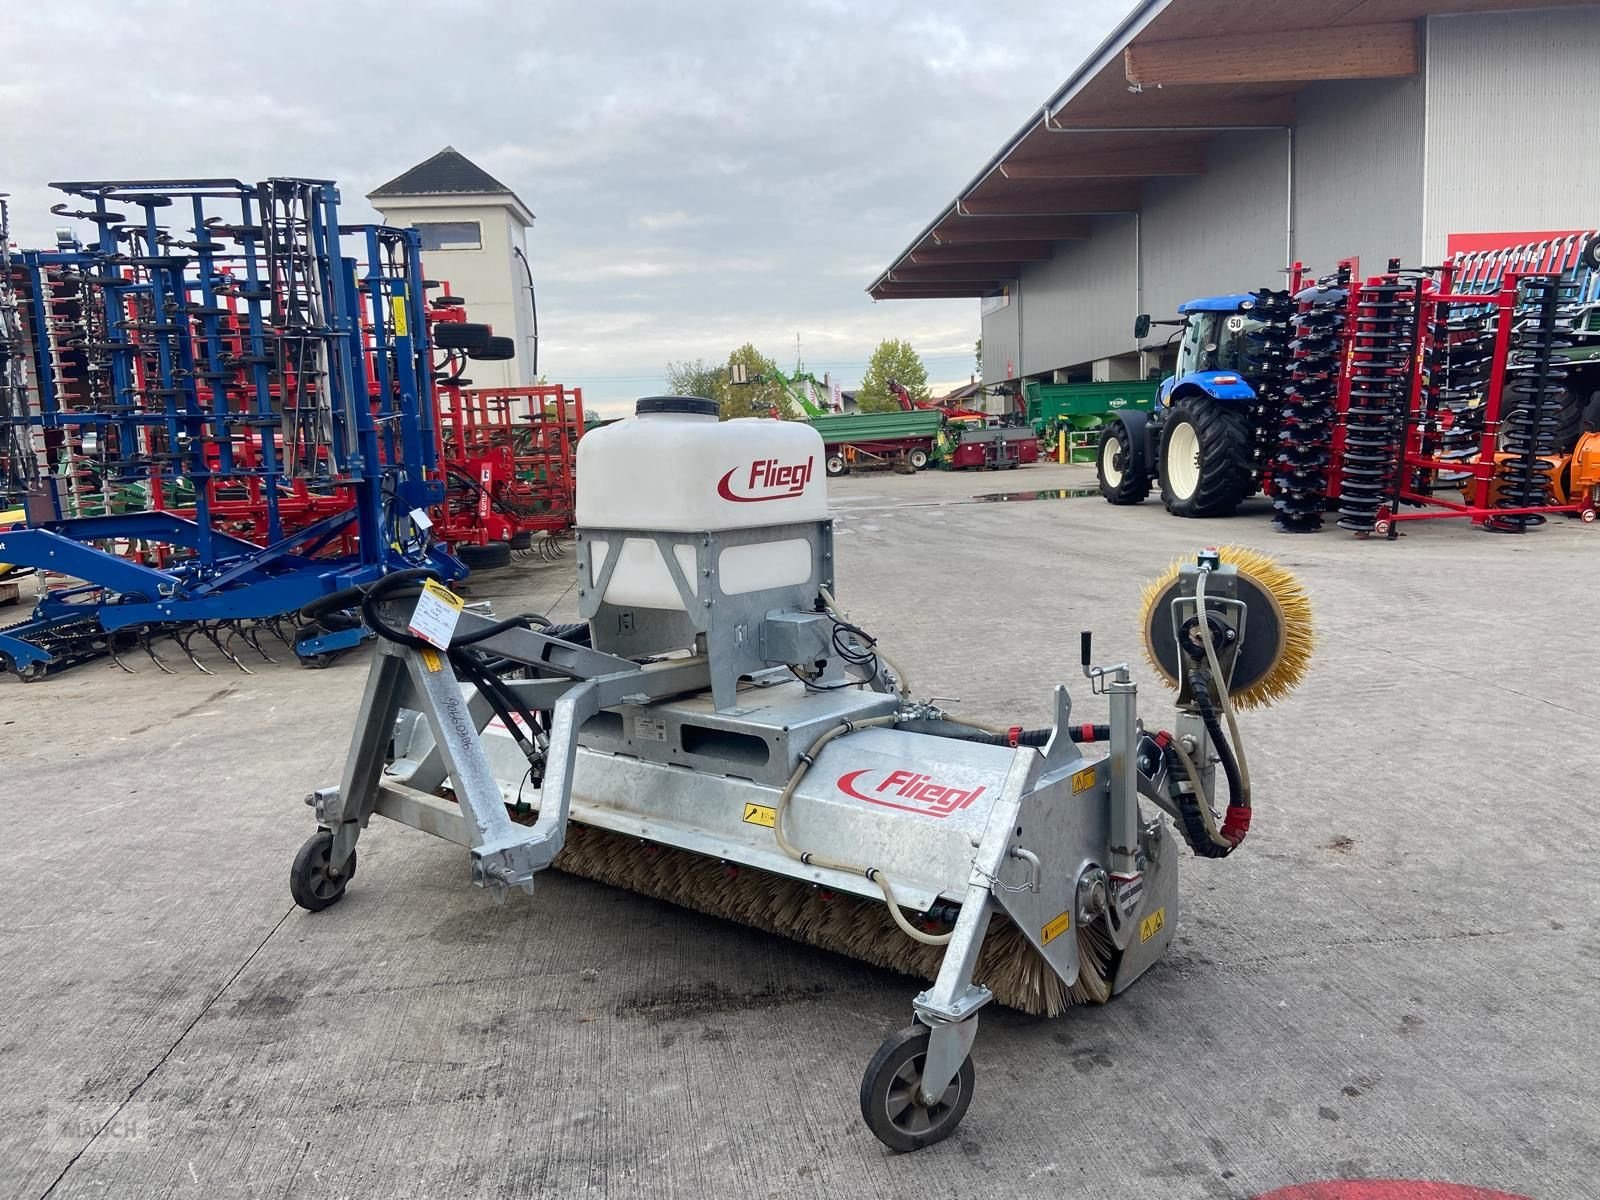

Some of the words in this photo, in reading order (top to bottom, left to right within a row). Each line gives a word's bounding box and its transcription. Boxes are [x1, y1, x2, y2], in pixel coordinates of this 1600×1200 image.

[1230, 319, 1241, 329] 50
[748, 455, 814, 492] Fliegl
[875, 770, 987, 813] Fliegl
